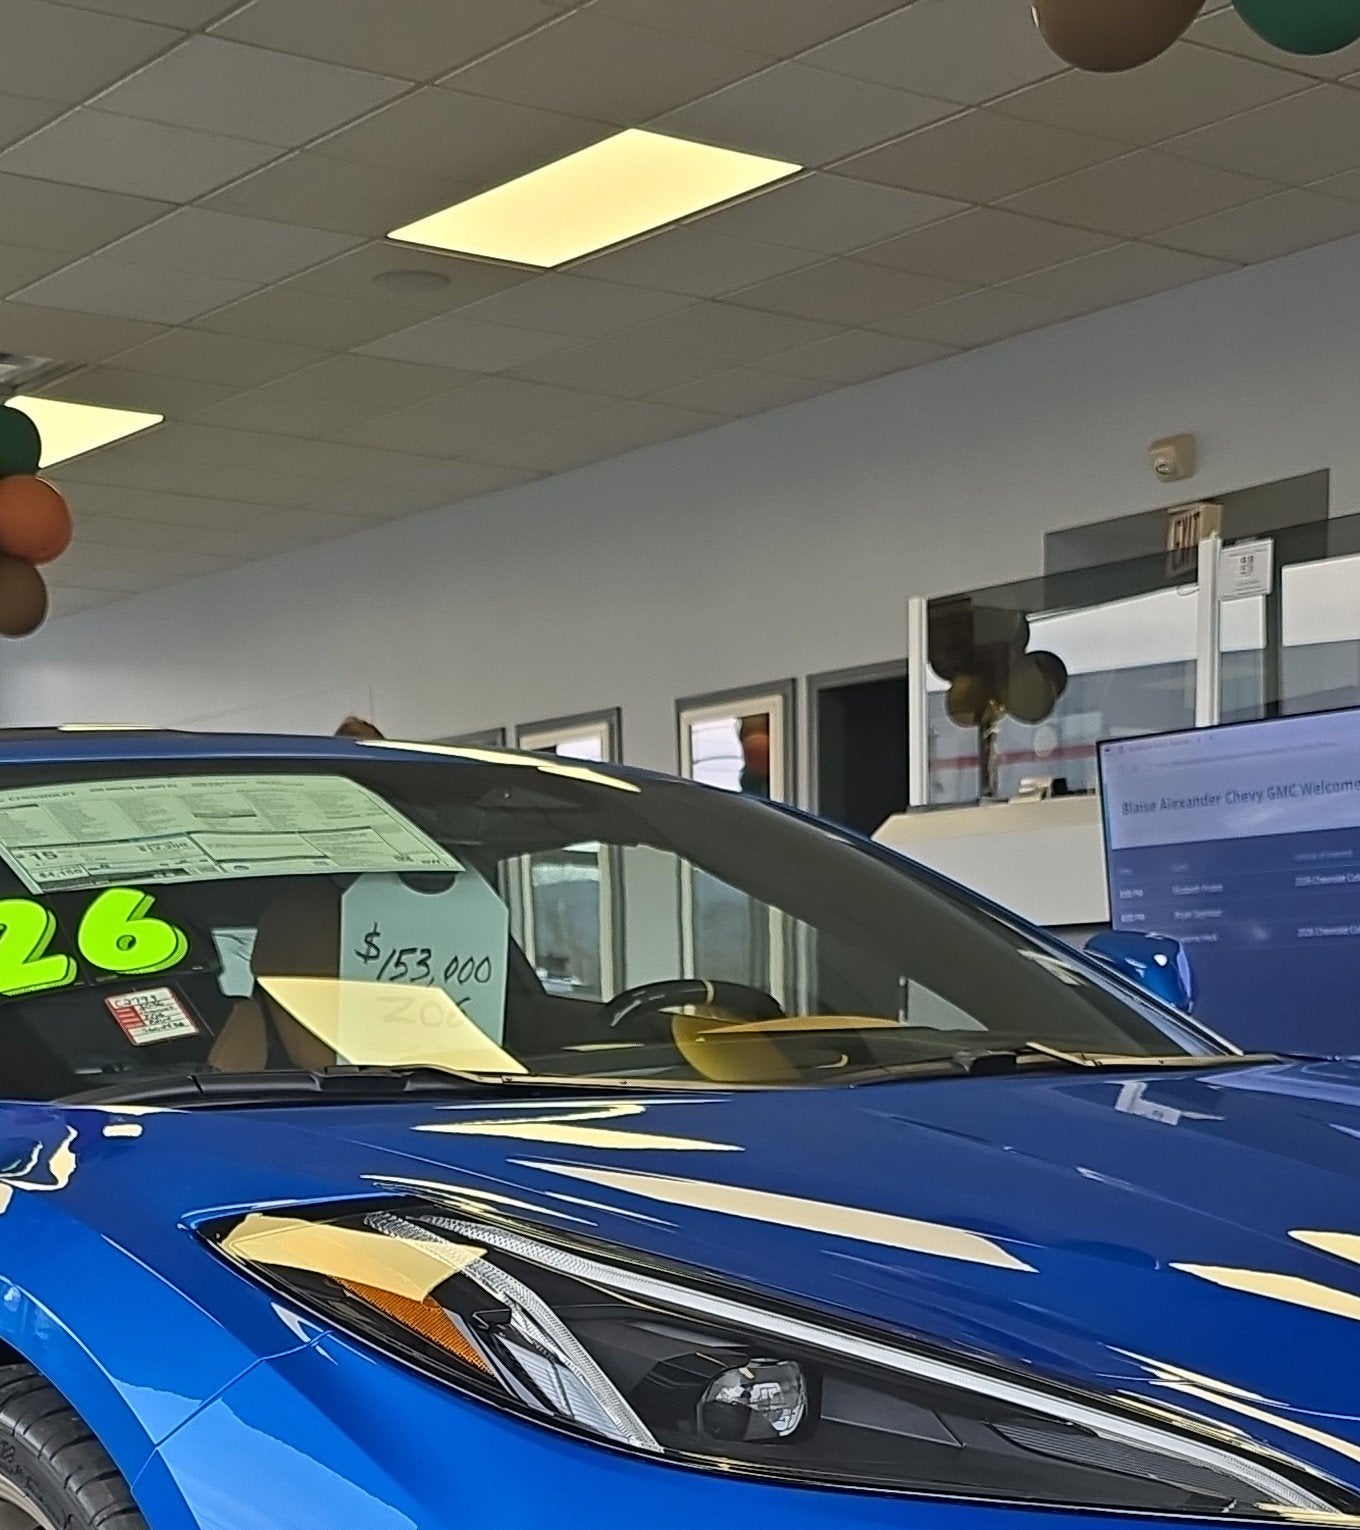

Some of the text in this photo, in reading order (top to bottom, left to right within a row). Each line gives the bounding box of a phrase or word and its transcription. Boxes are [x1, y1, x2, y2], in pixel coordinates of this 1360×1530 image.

[1159, 795, 1222, 812] Alexander
[1224, 789, 1263, 806] Chevy
[1266, 784, 1297, 799] GMC
[353, 922, 492, 986] $153,000
